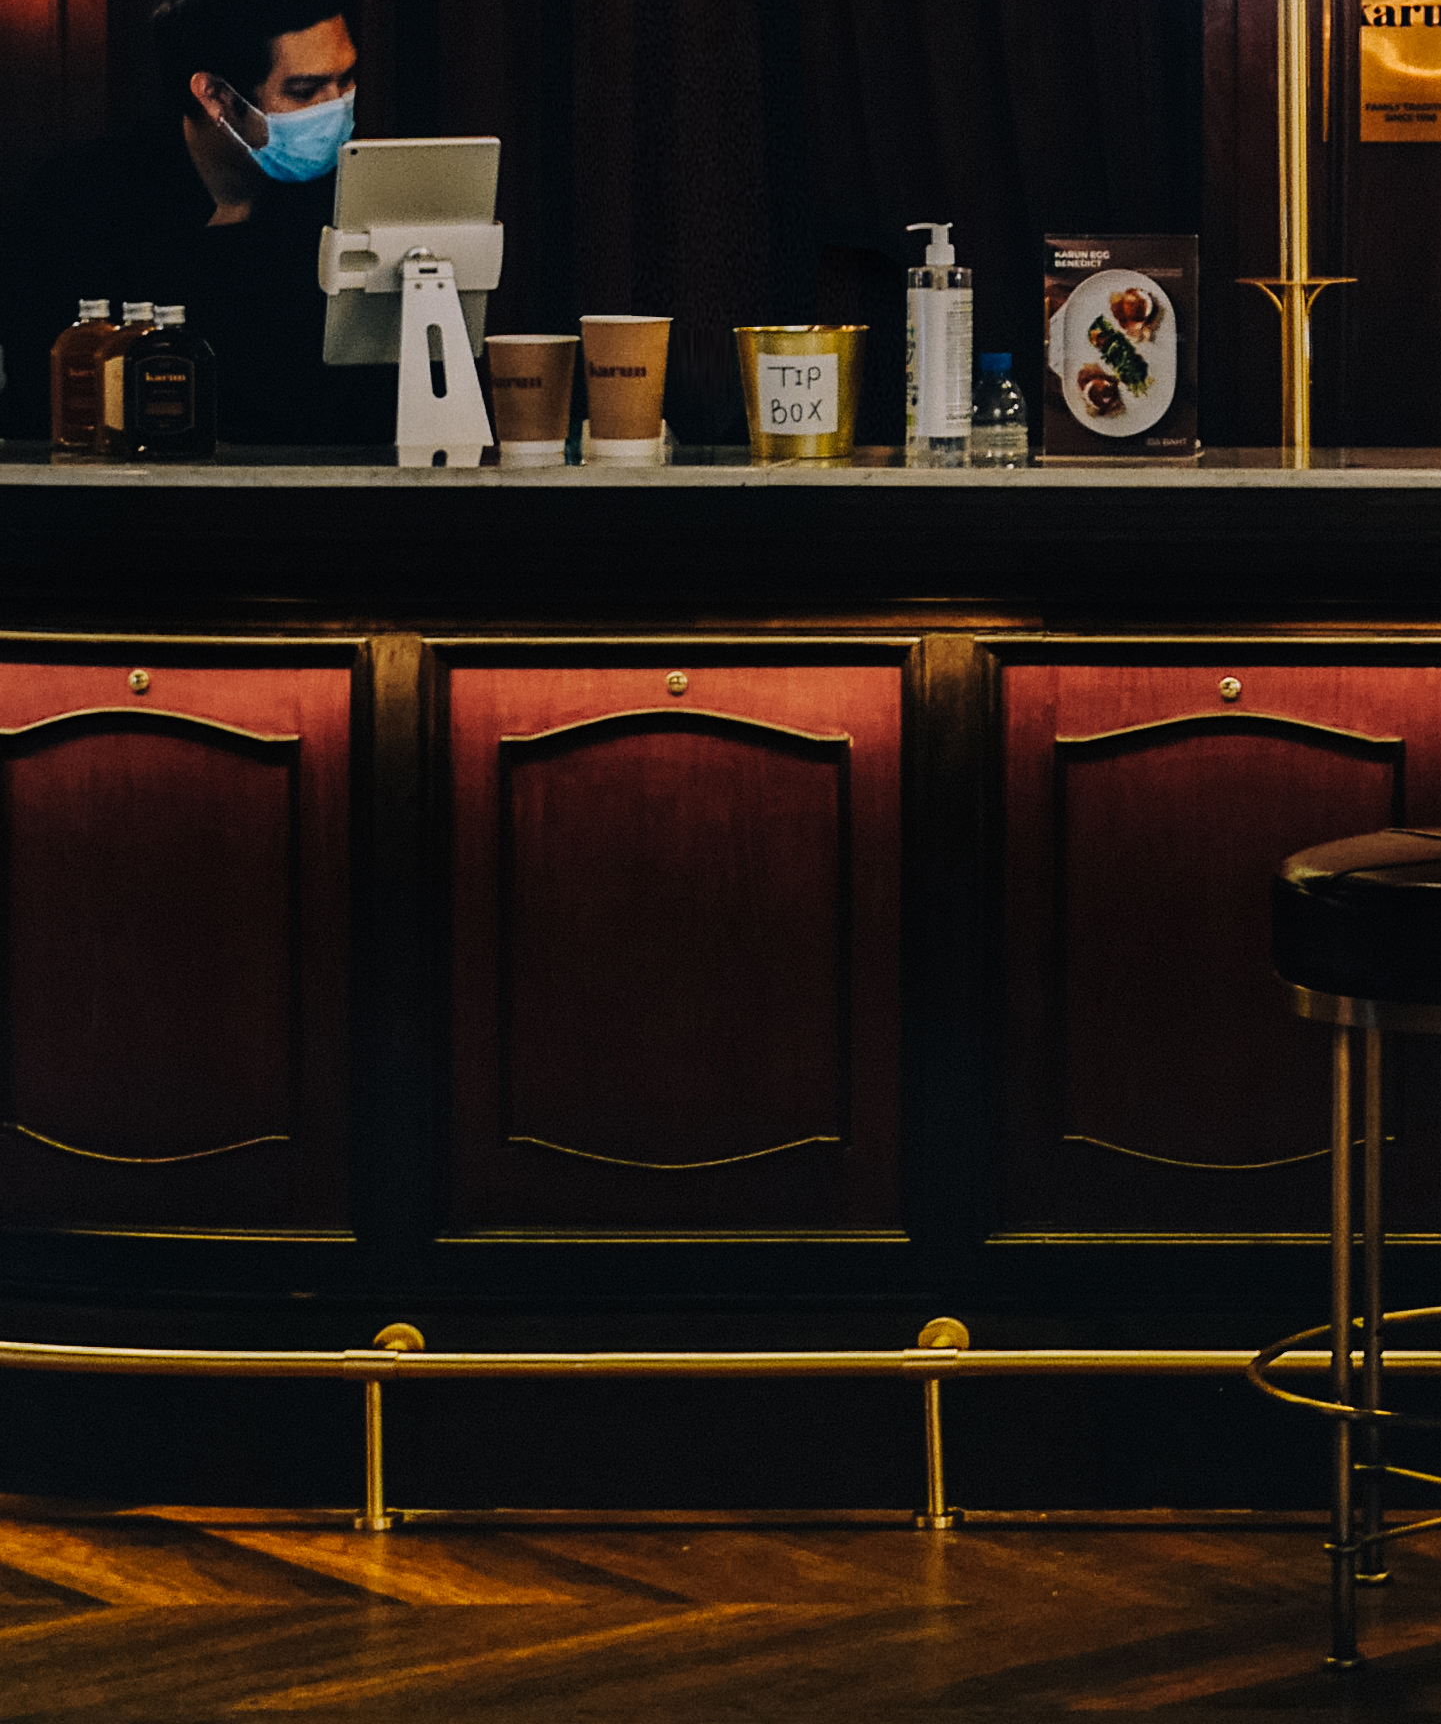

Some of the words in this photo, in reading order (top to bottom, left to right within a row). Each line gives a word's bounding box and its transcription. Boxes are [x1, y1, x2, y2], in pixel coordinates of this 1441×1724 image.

[1054, 250, 1088, 259] KARUN
[1054, 259, 1102, 268] BENEDICT
[767, 366, 822, 390] TIP
[771, 398, 823, 425] BOX
